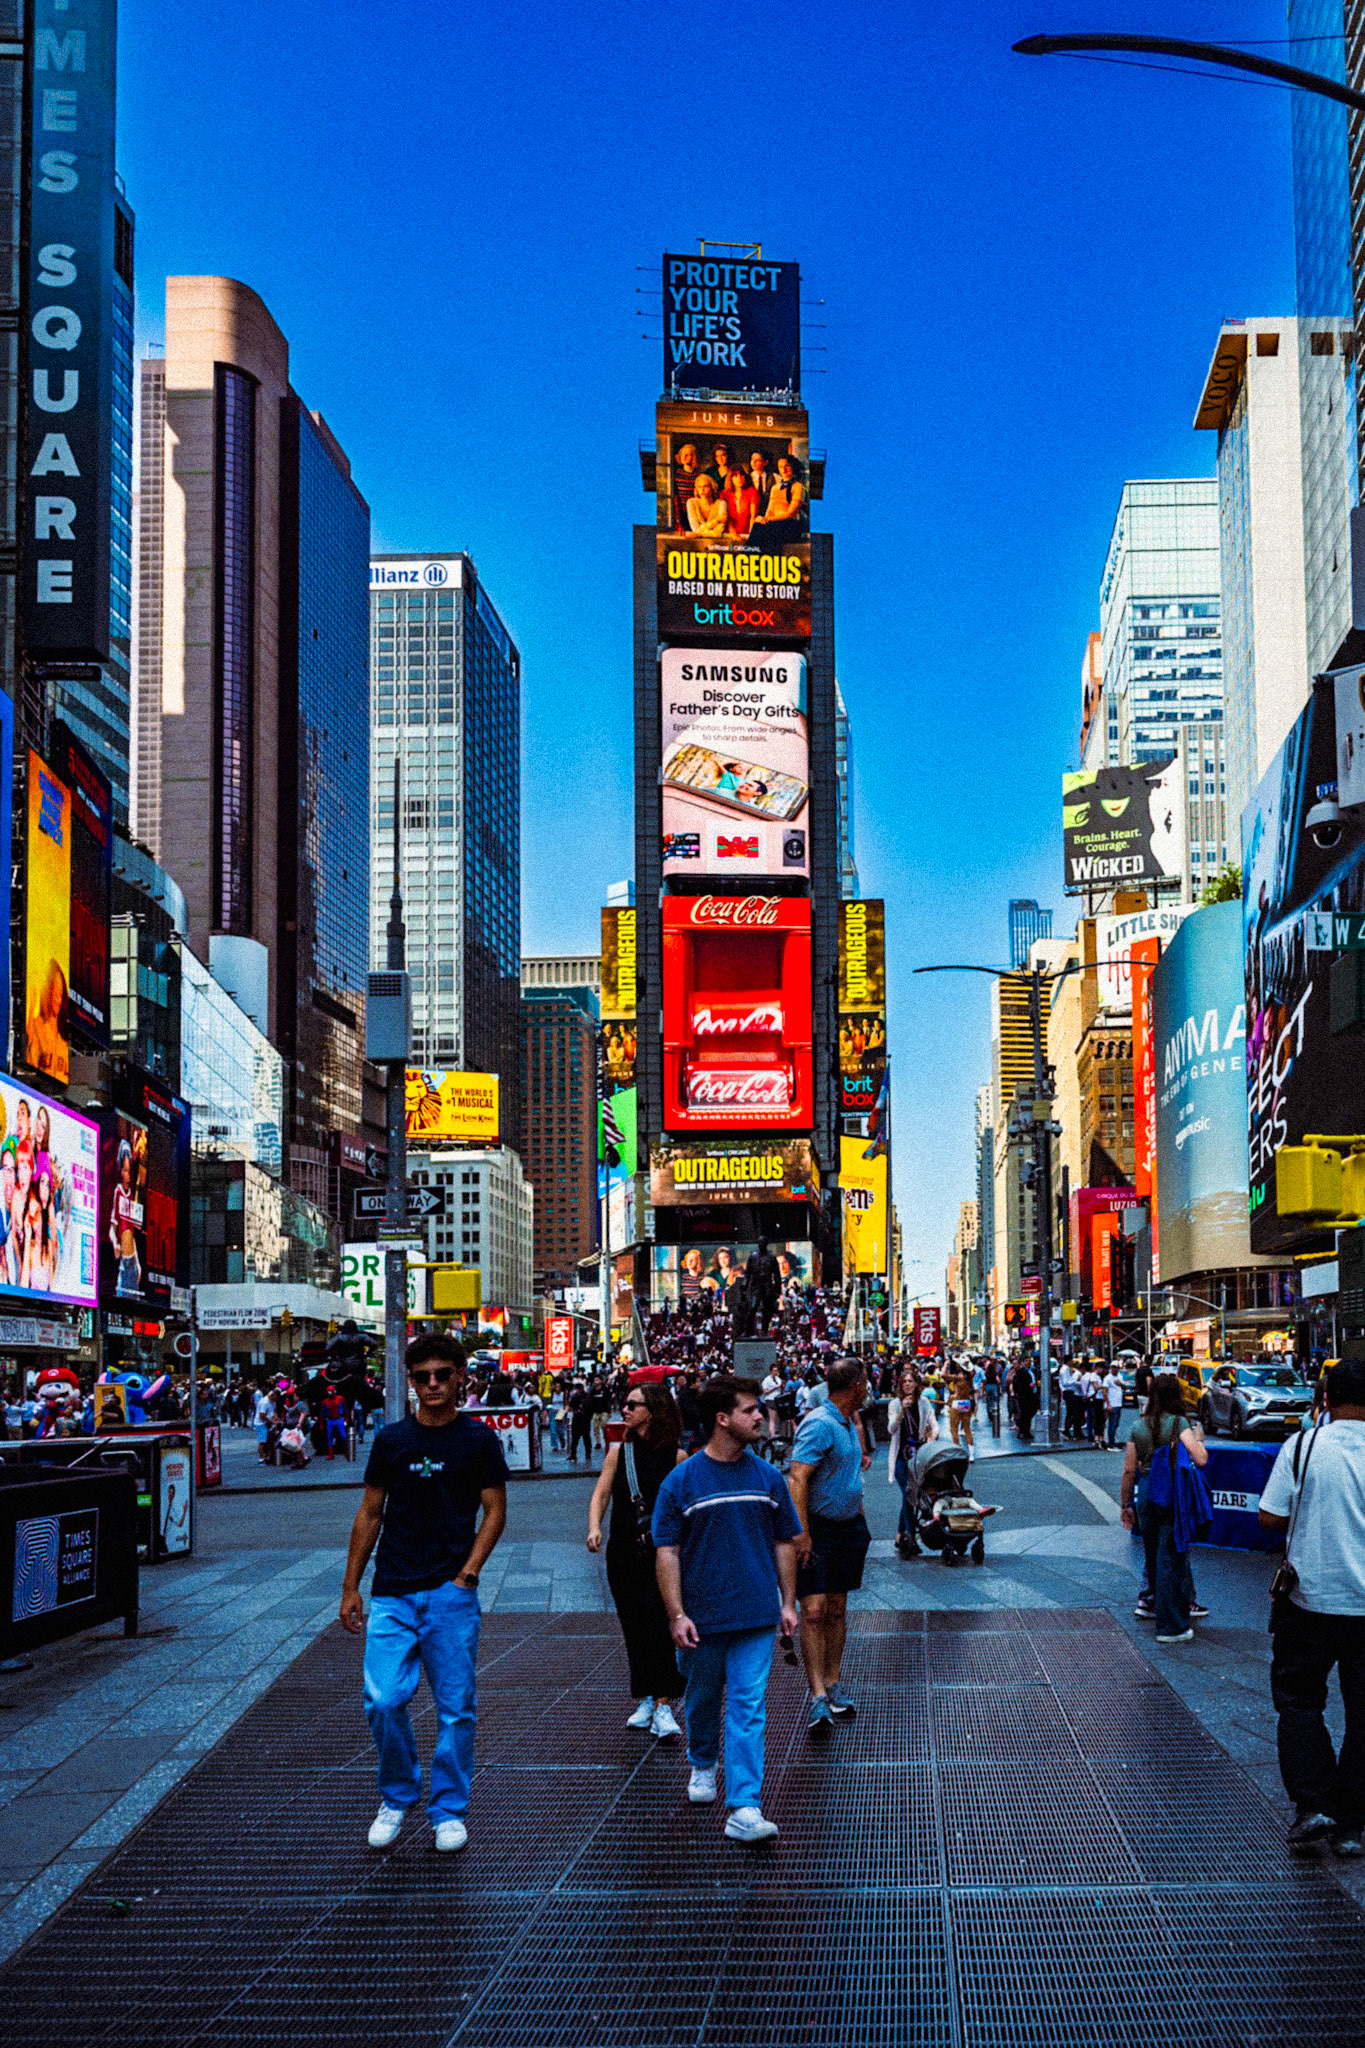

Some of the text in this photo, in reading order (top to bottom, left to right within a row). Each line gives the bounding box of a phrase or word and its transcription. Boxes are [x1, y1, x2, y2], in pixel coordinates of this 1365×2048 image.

[669, 261, 781, 292] PROTECT
[669, 286, 738, 315] YOUR
[670, 312, 741, 341] LIFE'S
[671, 340, 747, 368] WORK
[31, 244, 82, 604] SQUARE
[690, 411, 775, 427] JUNE 18
[667, 551, 802, 584] OUTRAGEOUS
[668, 580, 801, 600] BASED ON A TRUE STORY
[693, 602, 775, 626] britbox
[681, 664, 788, 684] SAMSUNG
[702, 690, 766, 703] Discover
[670, 703, 800, 721] Father's Day Gifts
[1073, 827, 1142, 845] Brains. Heart.
[1086, 840, 1130, 853] Courage.
[690, 894, 783, 925] Coca-Cola
[1107, 913, 1156, 947] LITTLE
[1335, 918, 1350, 946] W
[617, 910, 637, 1006] OUTRAGEOUS
[845, 903, 867, 999] OUTRAGEOUS
[1140, 952, 1152, 1146] CANNABIS
[451, 1087, 463, 1096] THE
[843, 1075, 874, 1092] brit
[457, 1097, 494, 1109] MUSICAL
[842, 1090, 875, 1106] box
[674, 1156, 784, 1182] OUTRAGEOUS
[368, 1197, 387, 1209] ON
[709, 1191, 750, 1200] JUNE 18
[203, 1309, 237, 1317] PEDESTRIAN
[238, 1309, 253, 1317] FLOW
[1019, 1307, 1026, 1322] 9
[551, 1319, 570, 1354] tkts
[920, 1309, 937, 1344] tkts
[65, 1530, 91, 1548] TIMES
[62, 1548, 93, 1571] SQUARE
